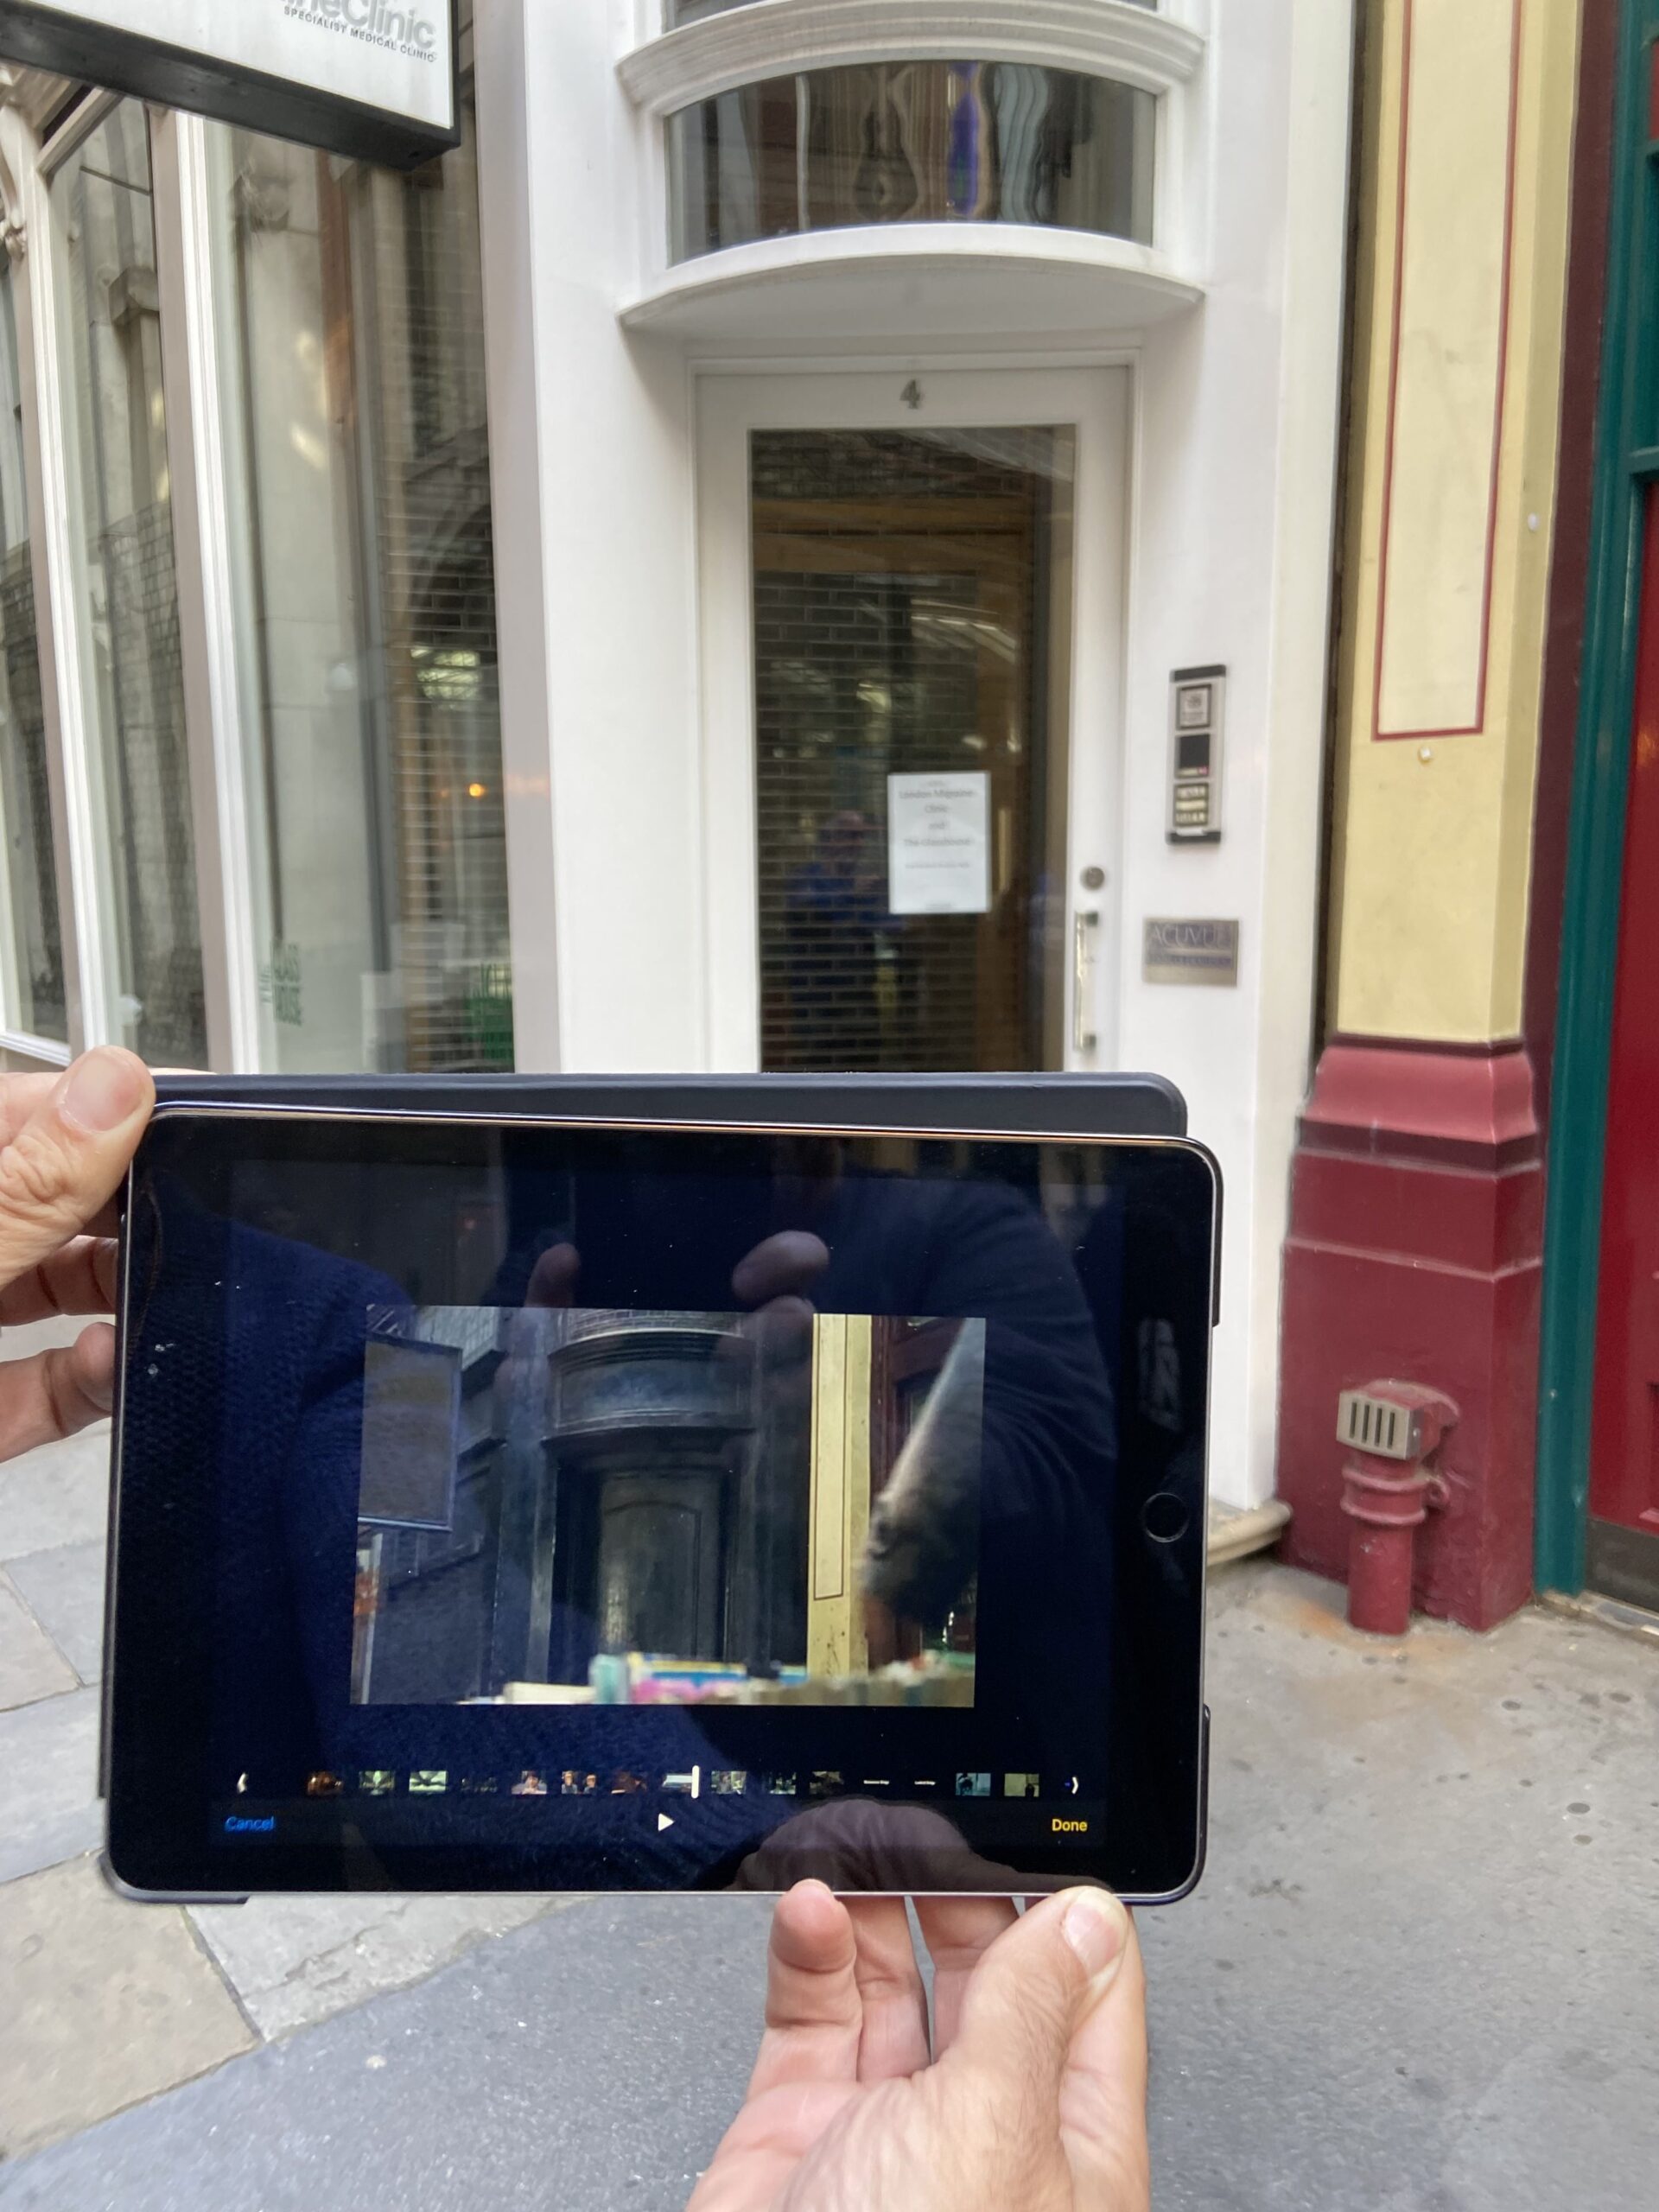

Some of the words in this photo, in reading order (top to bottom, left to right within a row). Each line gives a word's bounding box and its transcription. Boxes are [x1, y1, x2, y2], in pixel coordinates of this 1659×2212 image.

[283, 5, 346, 34] SPECIALIST
[350, 28, 397, 51] MEDICAL
[400, 45, 435, 63] CLINIC
[899, 379, 922, 410] 4
[225, 1815, 275, 1832] Cancel
[1052, 1818, 1088, 1832] Done
